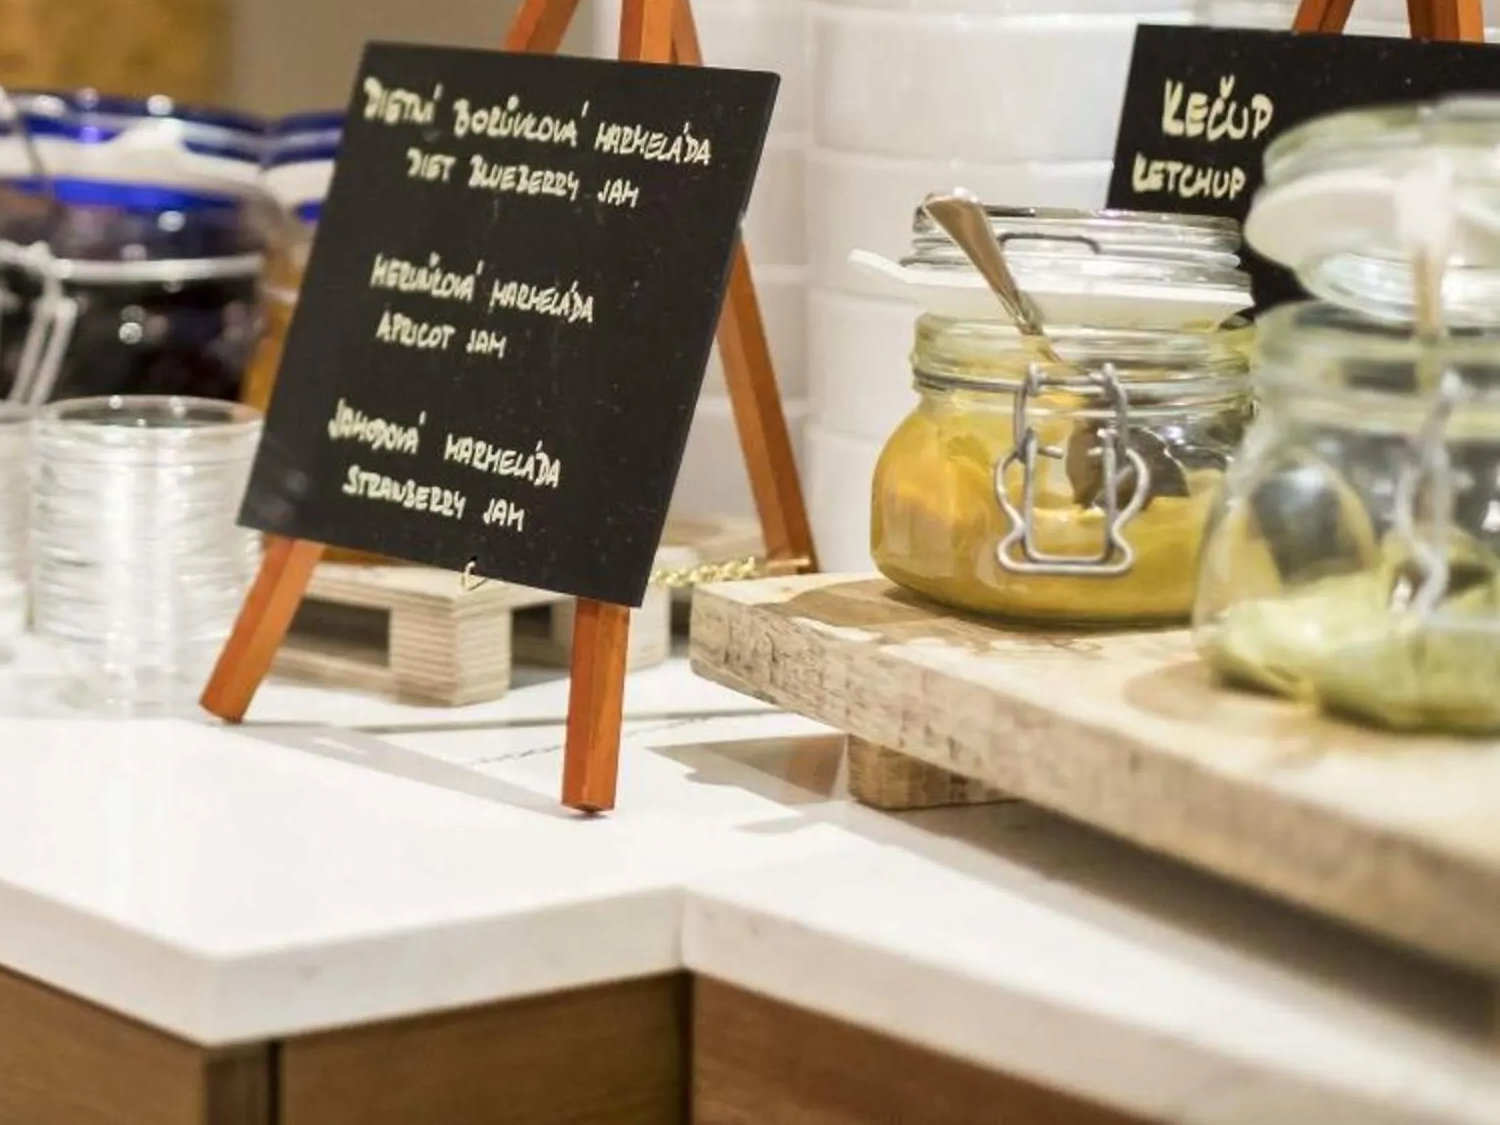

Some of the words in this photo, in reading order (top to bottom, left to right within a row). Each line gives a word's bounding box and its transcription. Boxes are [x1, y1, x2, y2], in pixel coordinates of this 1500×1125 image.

[1162, 75, 1274, 141] KEČUP
[407, 148, 455, 182] DIET
[468, 154, 579, 201] BLUEBERRY
[598, 181, 639, 208] JAM
[1132, 152, 1245, 200] KETCHUP
[376, 310, 455, 349] APRICOT
[466, 329, 507, 358] JAM
[483, 498, 524, 532] JAM
